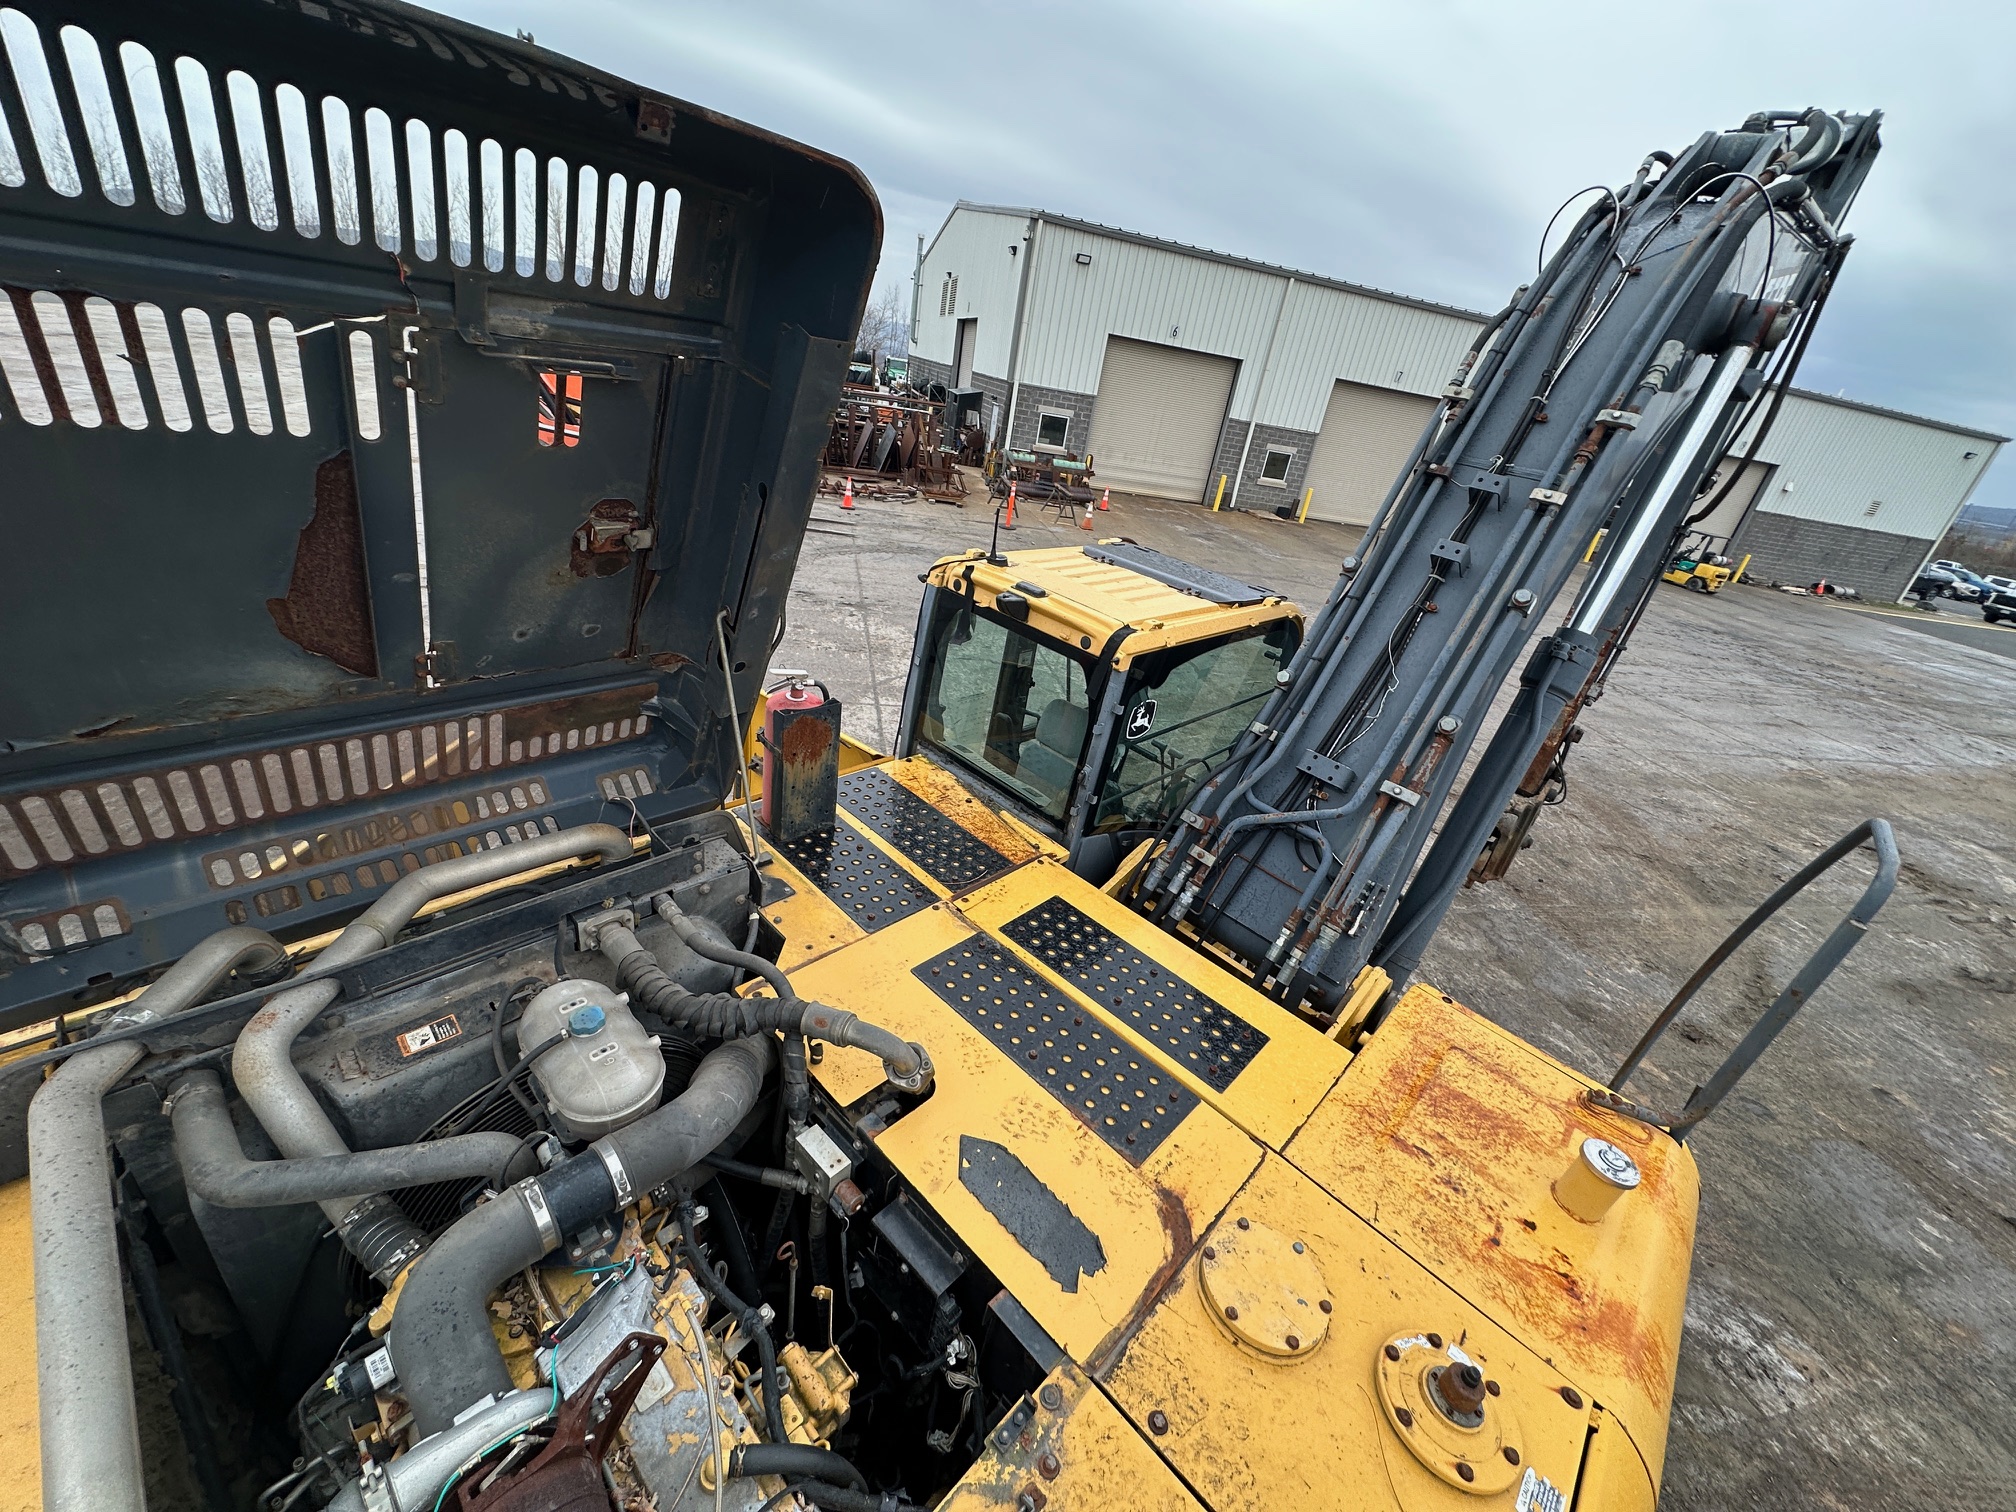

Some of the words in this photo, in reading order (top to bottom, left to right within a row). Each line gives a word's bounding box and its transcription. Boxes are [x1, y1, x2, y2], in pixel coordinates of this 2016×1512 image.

[1172, 326, 1179, 337] 6
[1397, 371, 1403, 382] 7
[1521, 1473, 1532, 1499] CAUTION
